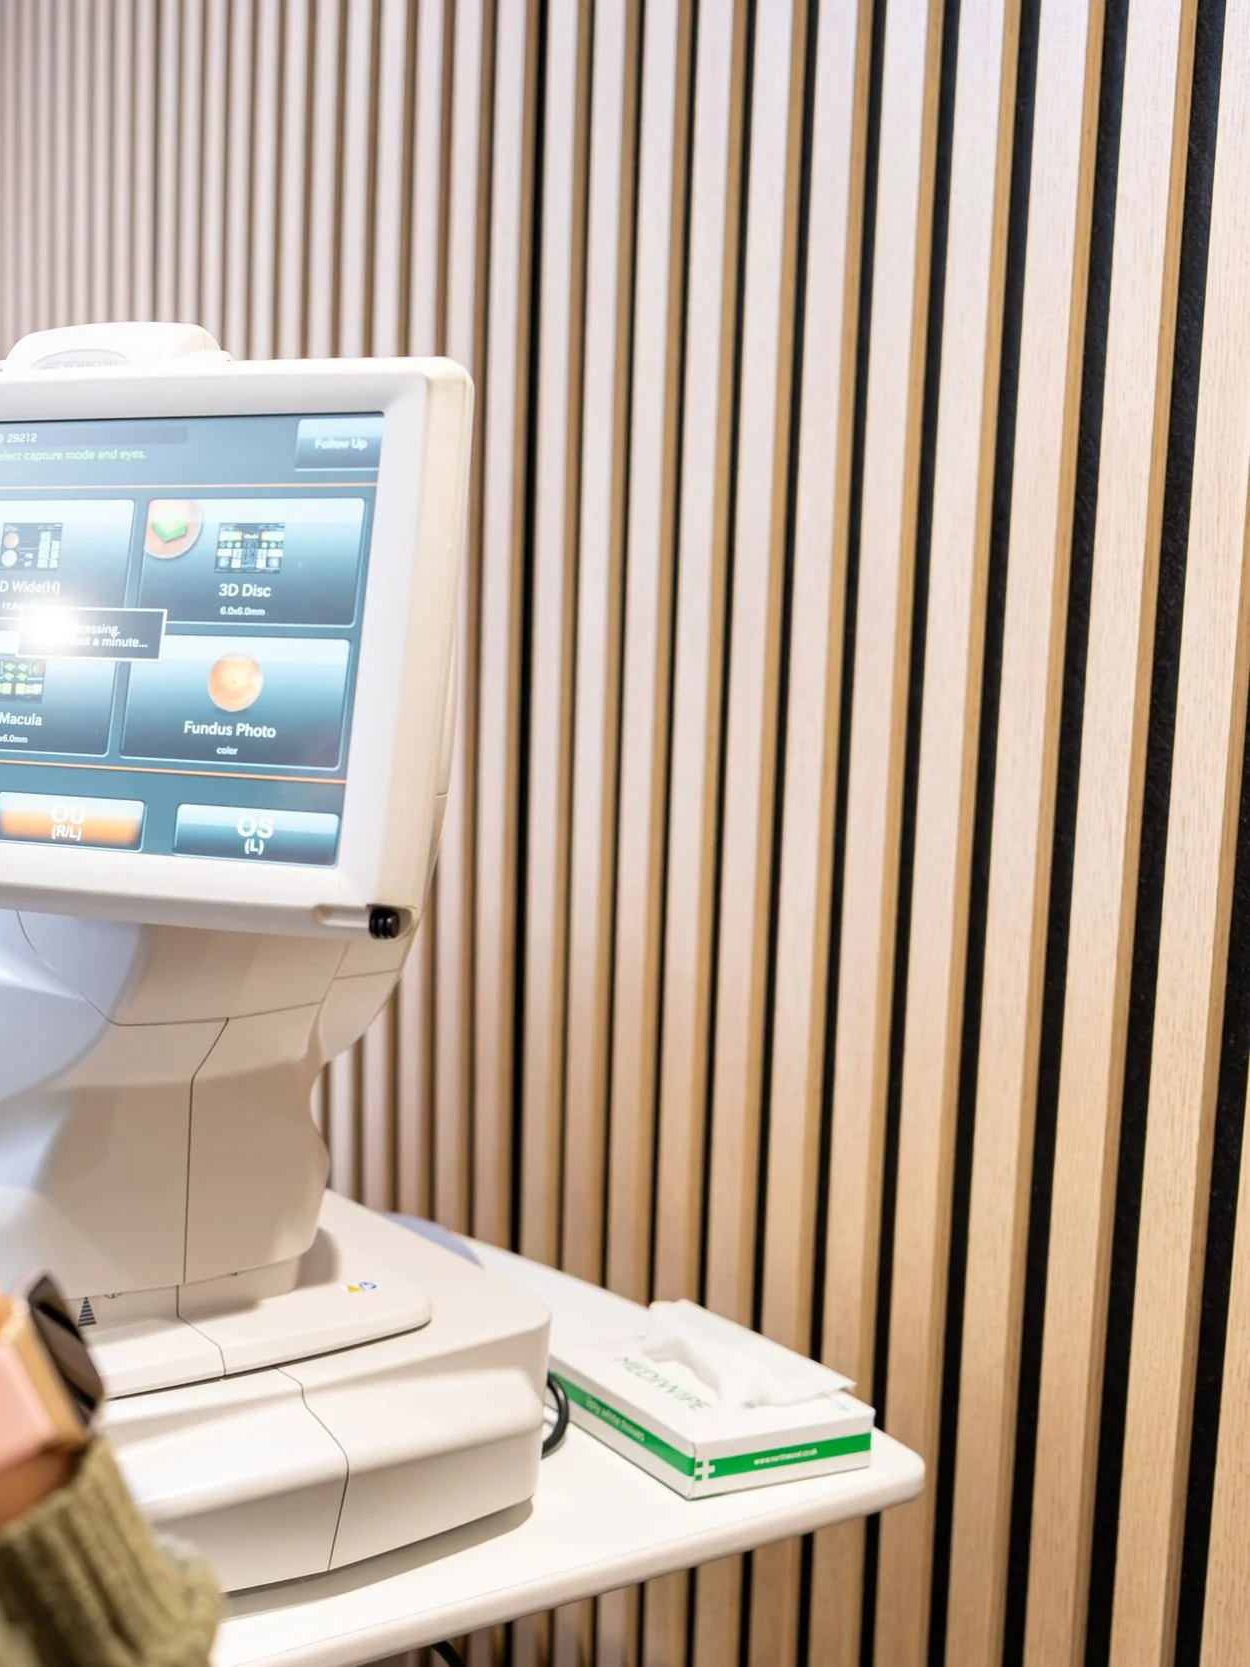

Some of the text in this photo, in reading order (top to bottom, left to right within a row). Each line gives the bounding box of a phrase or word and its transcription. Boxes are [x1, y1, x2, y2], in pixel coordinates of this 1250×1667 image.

[7, 432, 38, 443] 29212
[315, 438, 368, 451] Follow Up
[24, 450, 63, 463] capture
[66, 449, 95, 460] mode
[97, 448, 118, 459] and
[120, 449, 146, 461] eyes.
[11, 580, 61, 595] Wide(H)
[218, 583, 272, 598] 3D Disc
[219, 606, 266, 617] 6.0x6.0mm
[92, 638, 100, 646] a
[101, 635, 148, 649] minute...
[0, 711, 43, 726] Macula
[183, 720, 277, 739] Fundus Photo
[216, 745, 239, 755] color
[51, 803, 85, 824] OU
[51, 824, 82, 842] (R/L)
[236, 815, 275, 839] OS
[244, 838, 265, 856] (L)
